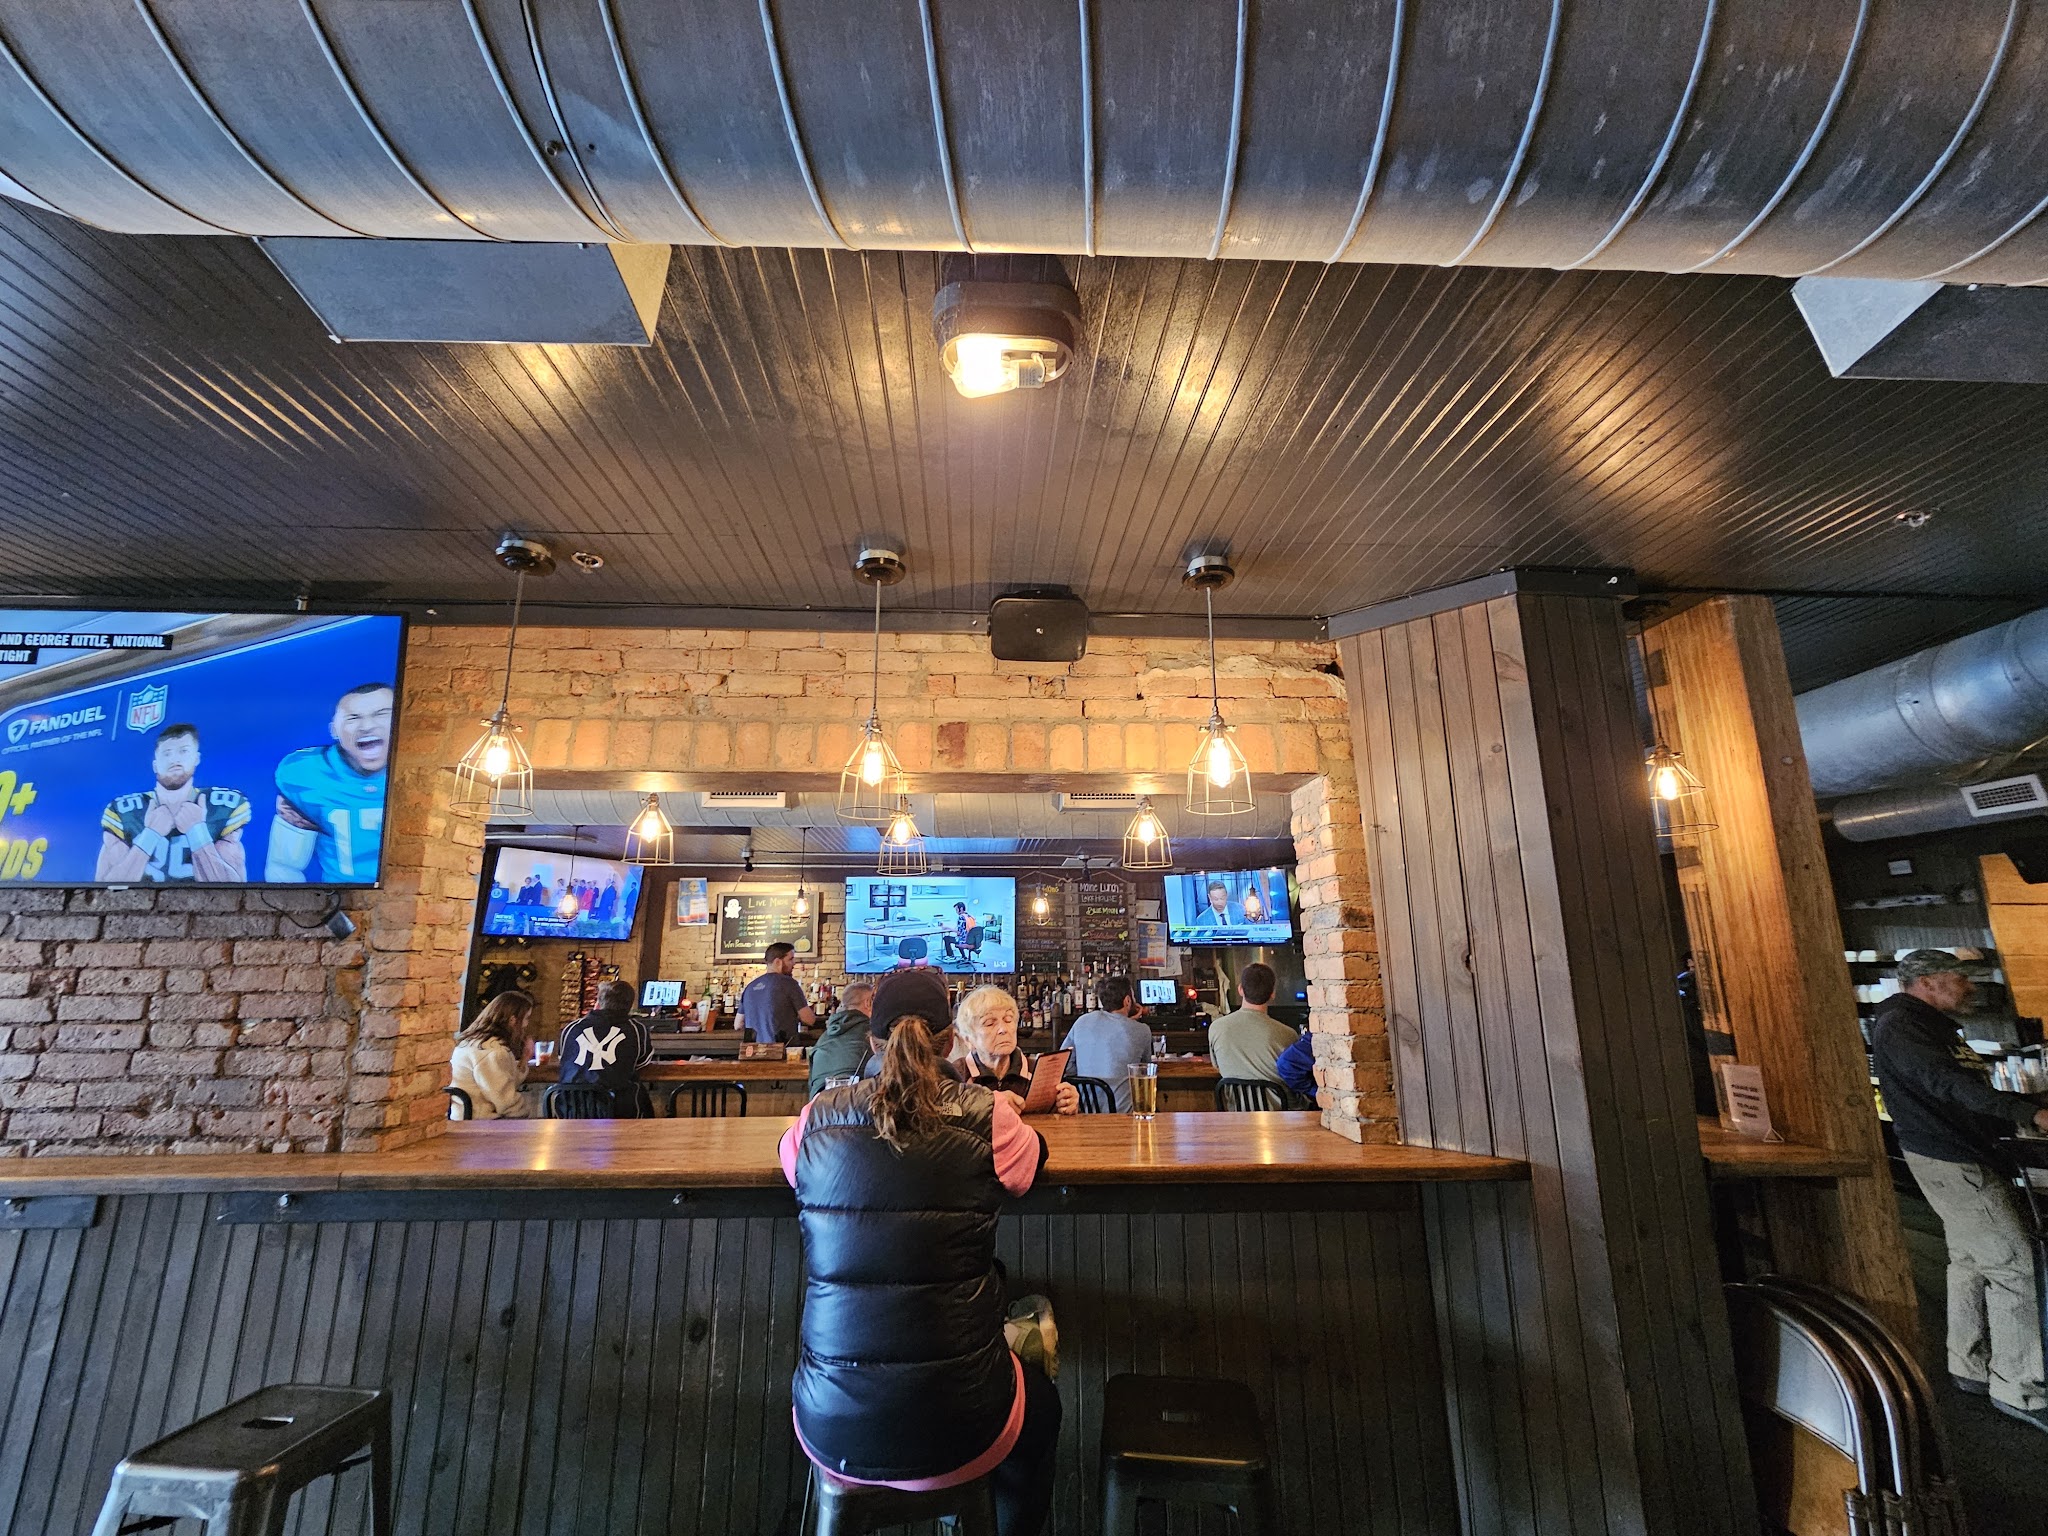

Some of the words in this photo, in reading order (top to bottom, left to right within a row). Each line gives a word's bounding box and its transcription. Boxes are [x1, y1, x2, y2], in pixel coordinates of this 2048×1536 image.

[0, 634, 22, 645] AND
[25, 634, 69, 646] GEORGE
[71, 635, 110, 648] KITTLE,
[113, 635, 165, 648] NATIONAL
[29, 706, 106, 736] FANDUEL
[132, 703, 160, 725] NFL
[573, 1025, 627, 1071] NY
